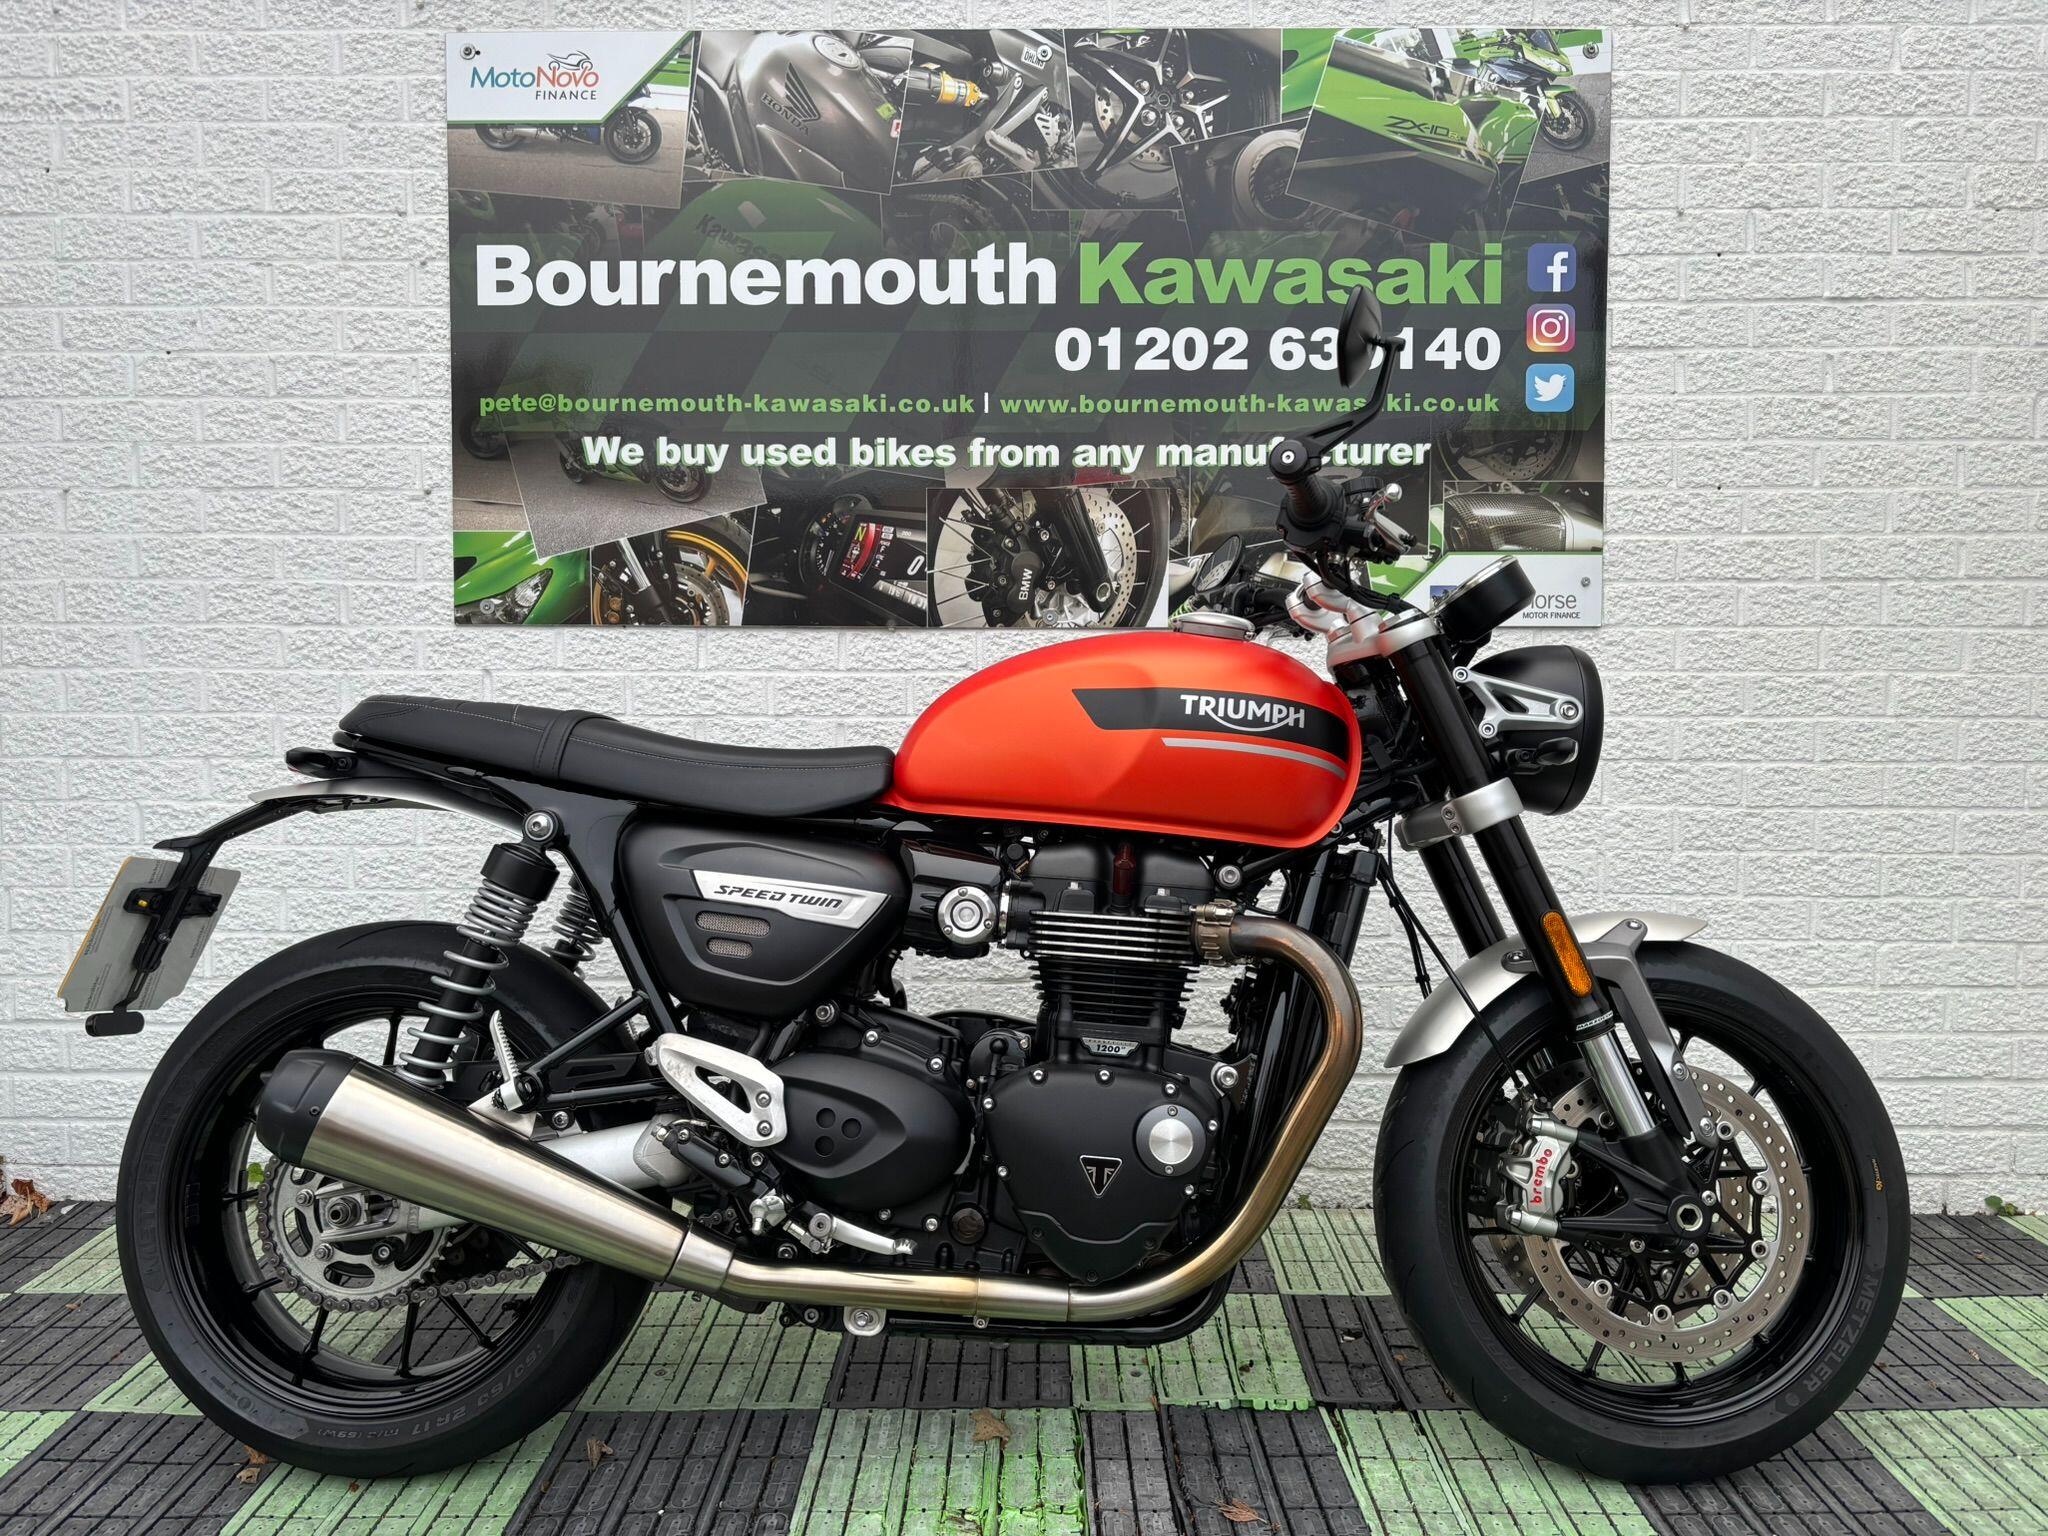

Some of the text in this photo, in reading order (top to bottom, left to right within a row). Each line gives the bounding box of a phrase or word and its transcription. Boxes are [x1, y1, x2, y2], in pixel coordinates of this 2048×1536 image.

[470, 66, 599, 88] MotoNovo
[535, 90, 597, 101] FINANCE
[761, 92, 809, 137] HONDA
[476, 242, 1502, 306] Bournemouth Kawasaki
[1054, 327, 1501, 371] 01202 63140
[480, 394, 975, 416] pete@bournemouth-kawasaki.co.uk
[1001, 394, 1499, 413] www.bournemouth-kawaski.co.uk
[583, 436, 1432, 473] We buy used bikes from any manuturer
[1018, 568, 1034, 601] BMW
[1522, 611, 1581, 620] MOTOR FINANCE
[1180, 694, 1305, 732] TRIUMPH
[713, 885, 843, 909] SPEED TWIN
[1530, 1149, 1553, 1204] brembo
[1803, 1272, 1880, 1393] METZELER
